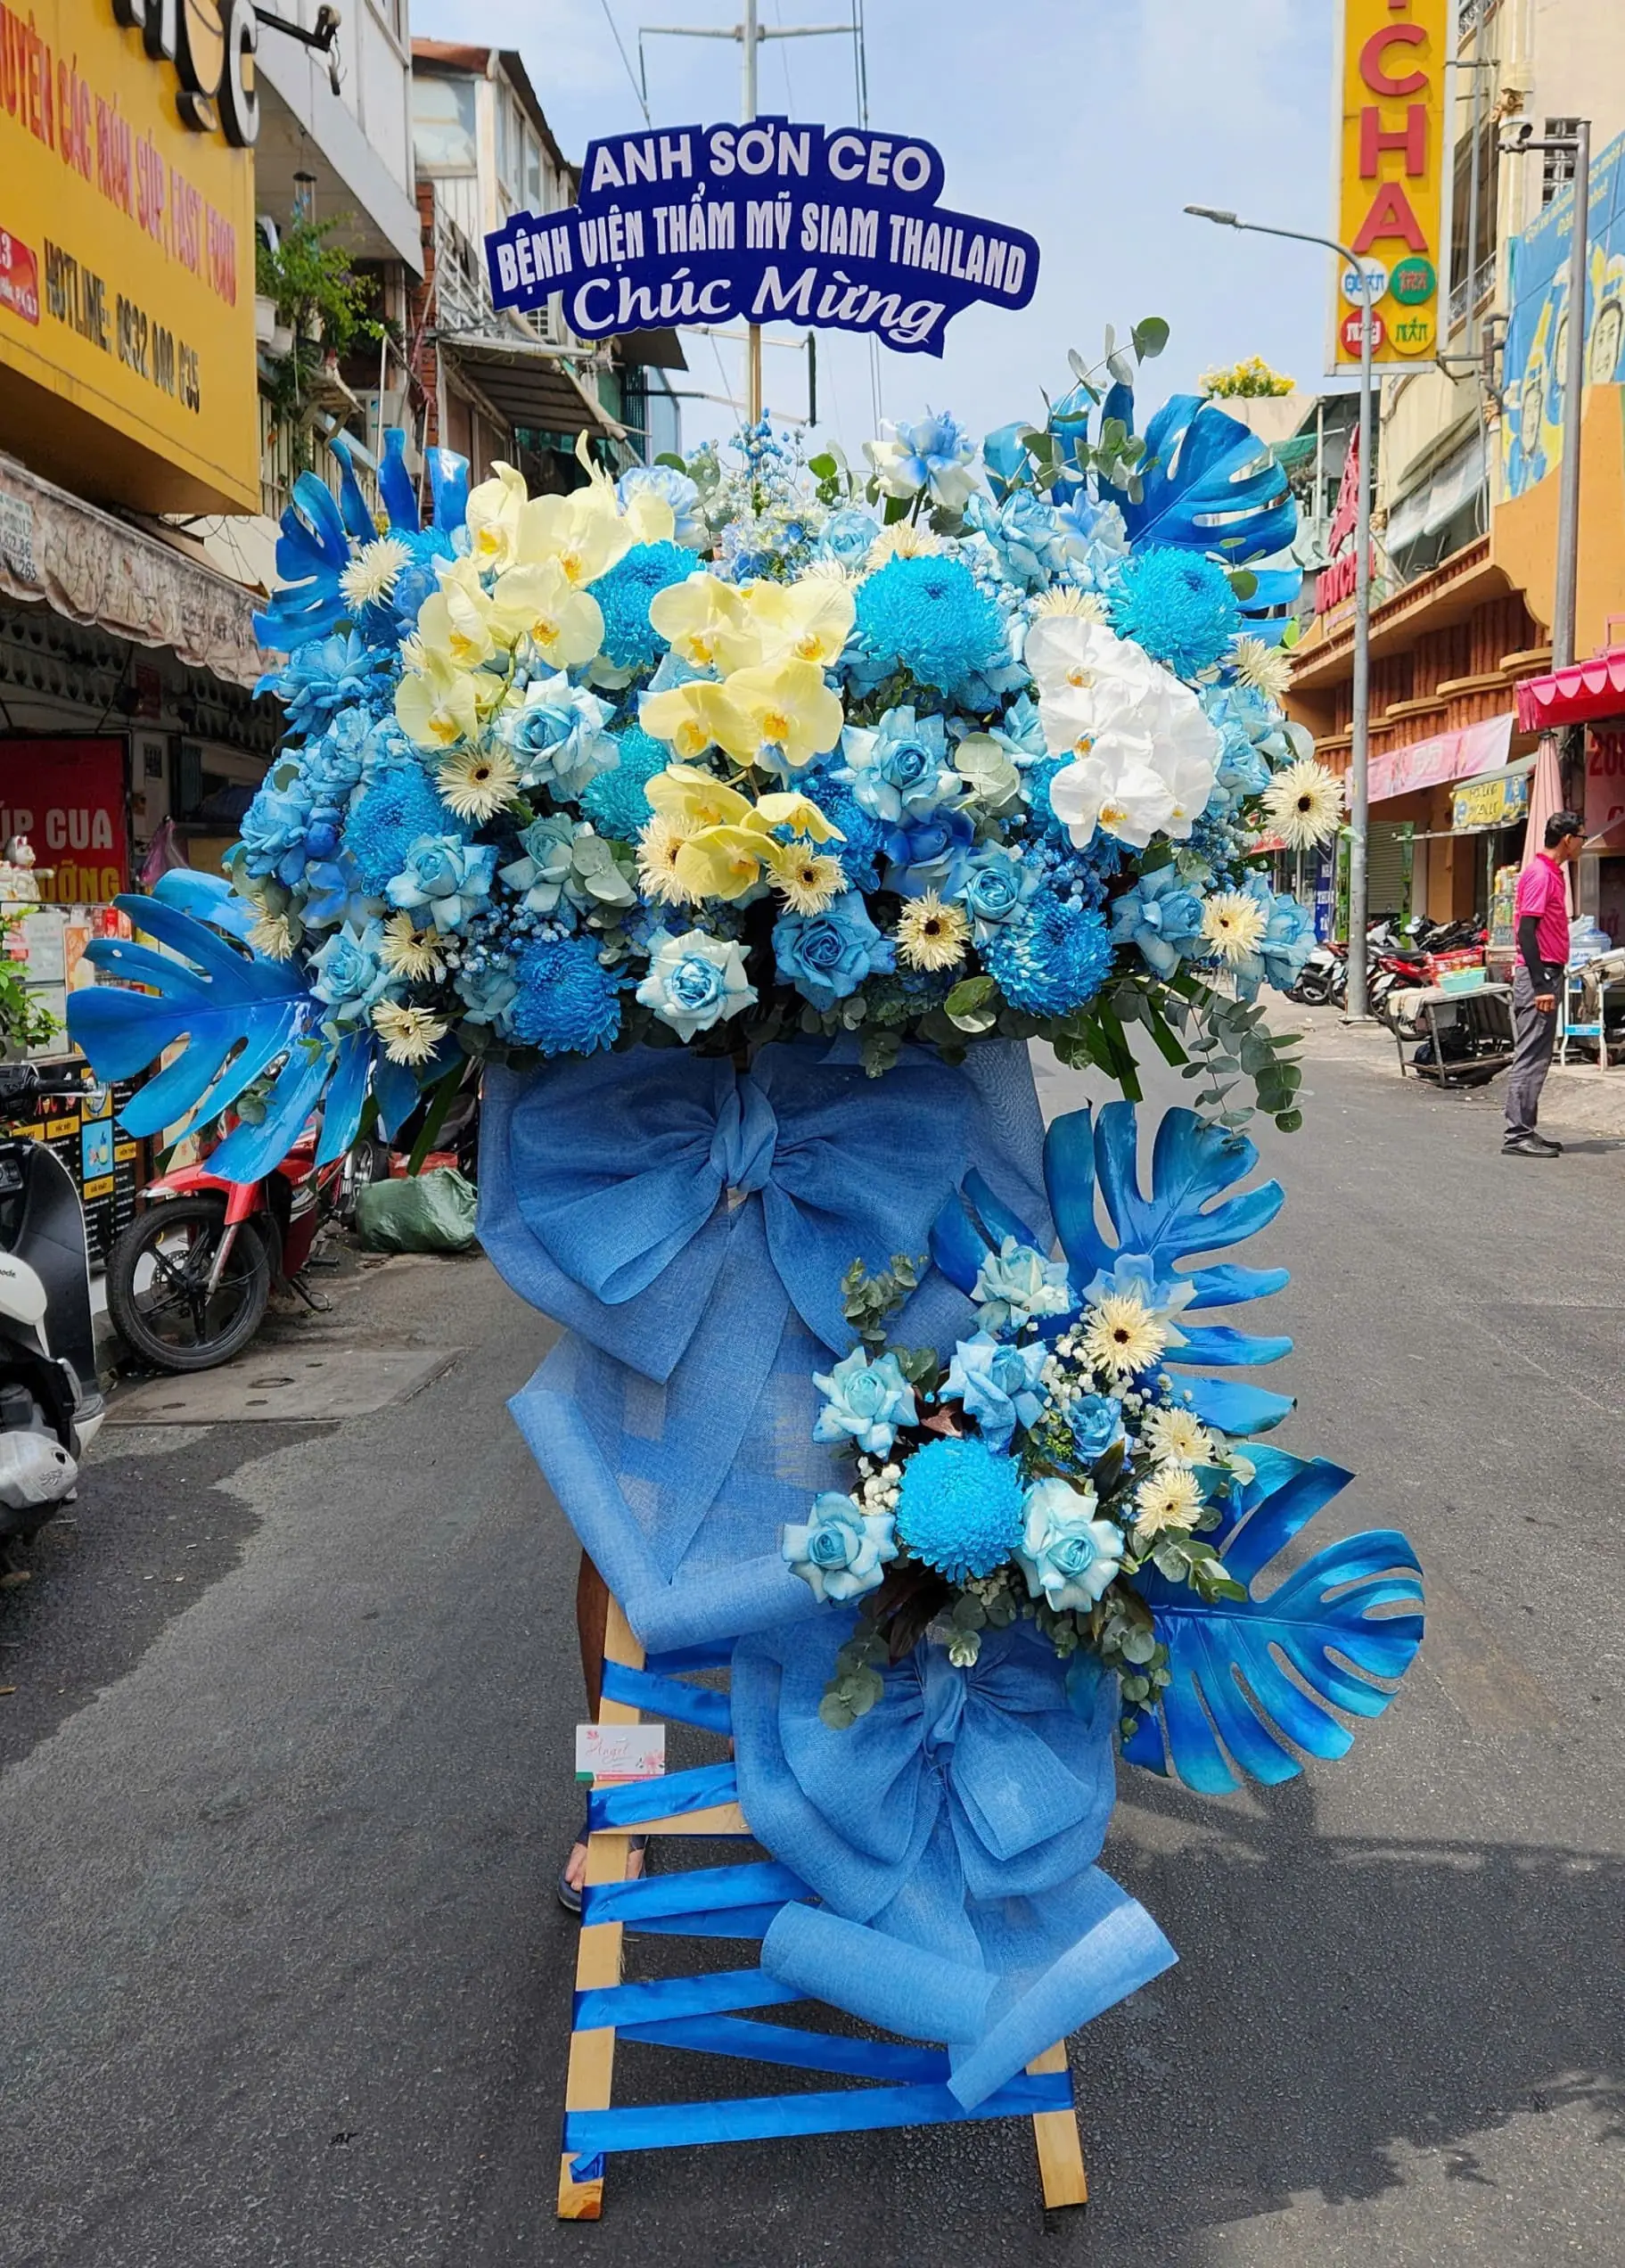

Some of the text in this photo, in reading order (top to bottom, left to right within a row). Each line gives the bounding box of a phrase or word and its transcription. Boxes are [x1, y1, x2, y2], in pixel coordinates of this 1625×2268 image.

[590, 123, 932, 193] ANH SƠN CEO
[1352, 0, 1428, 253] CHA
[57, 52, 92, 183] CÁC
[170, 165, 202, 280] FAST
[205, 201, 237, 308] FOOD
[497, 181, 1026, 295] BỆNH VIỆN THẨM MỸ SIAM THAILAND
[44, 235, 112, 356] HOTLINE:
[573, 266, 946, 344] Chúc Mừng
[45, 808, 112, 850] CUA
[39, 859, 119, 904] ƯỠNG
